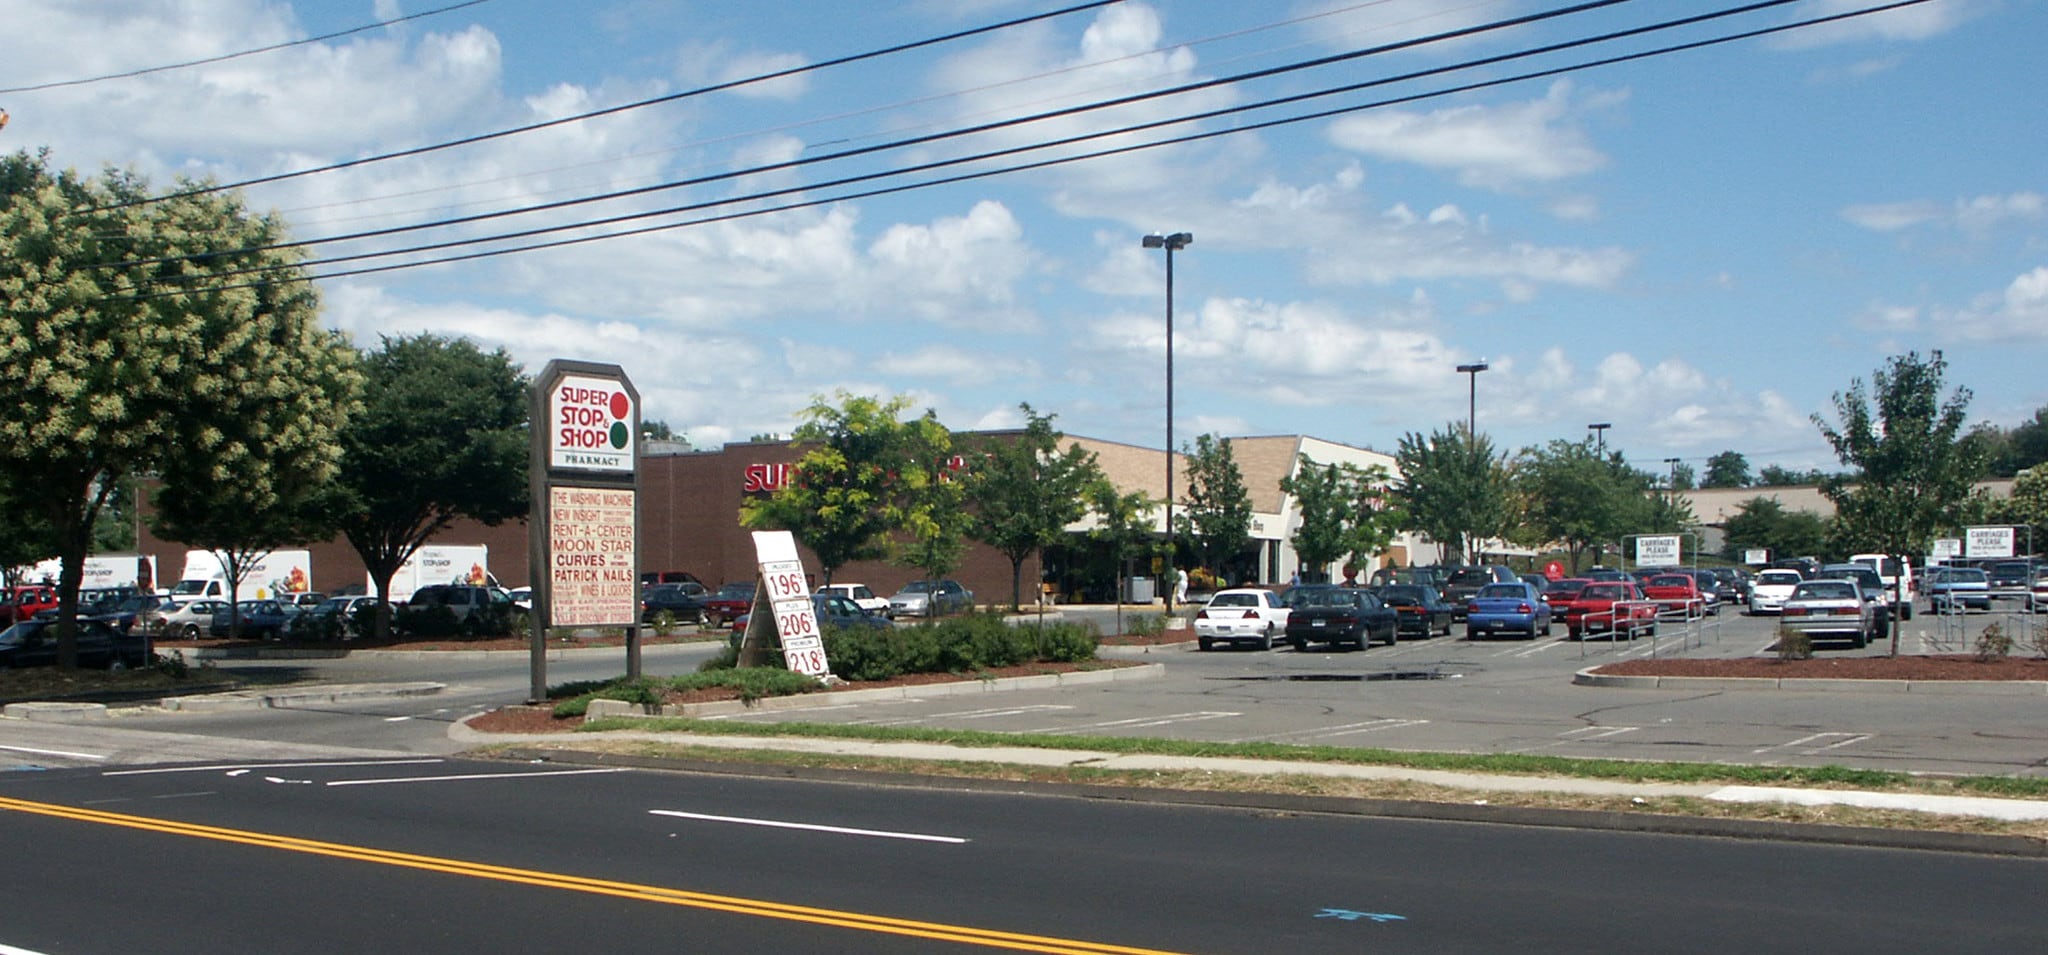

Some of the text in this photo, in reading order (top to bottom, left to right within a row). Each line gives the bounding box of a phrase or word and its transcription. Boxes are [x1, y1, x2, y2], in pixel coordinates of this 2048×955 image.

[560, 386, 609, 406] SUPER
[560, 406, 604, 427] STOP
[560, 428, 608, 448] SHOP
[565, 455, 620, 466] PHARMACY
[554, 491, 632, 507] THE WASHING MACHINE
[554, 509, 601, 522] NEW INSIGHT
[553, 539, 632, 552] MOON STAR
[556, 554, 606, 567] CURVES
[555, 569, 633, 582] PATRICK NAILS
